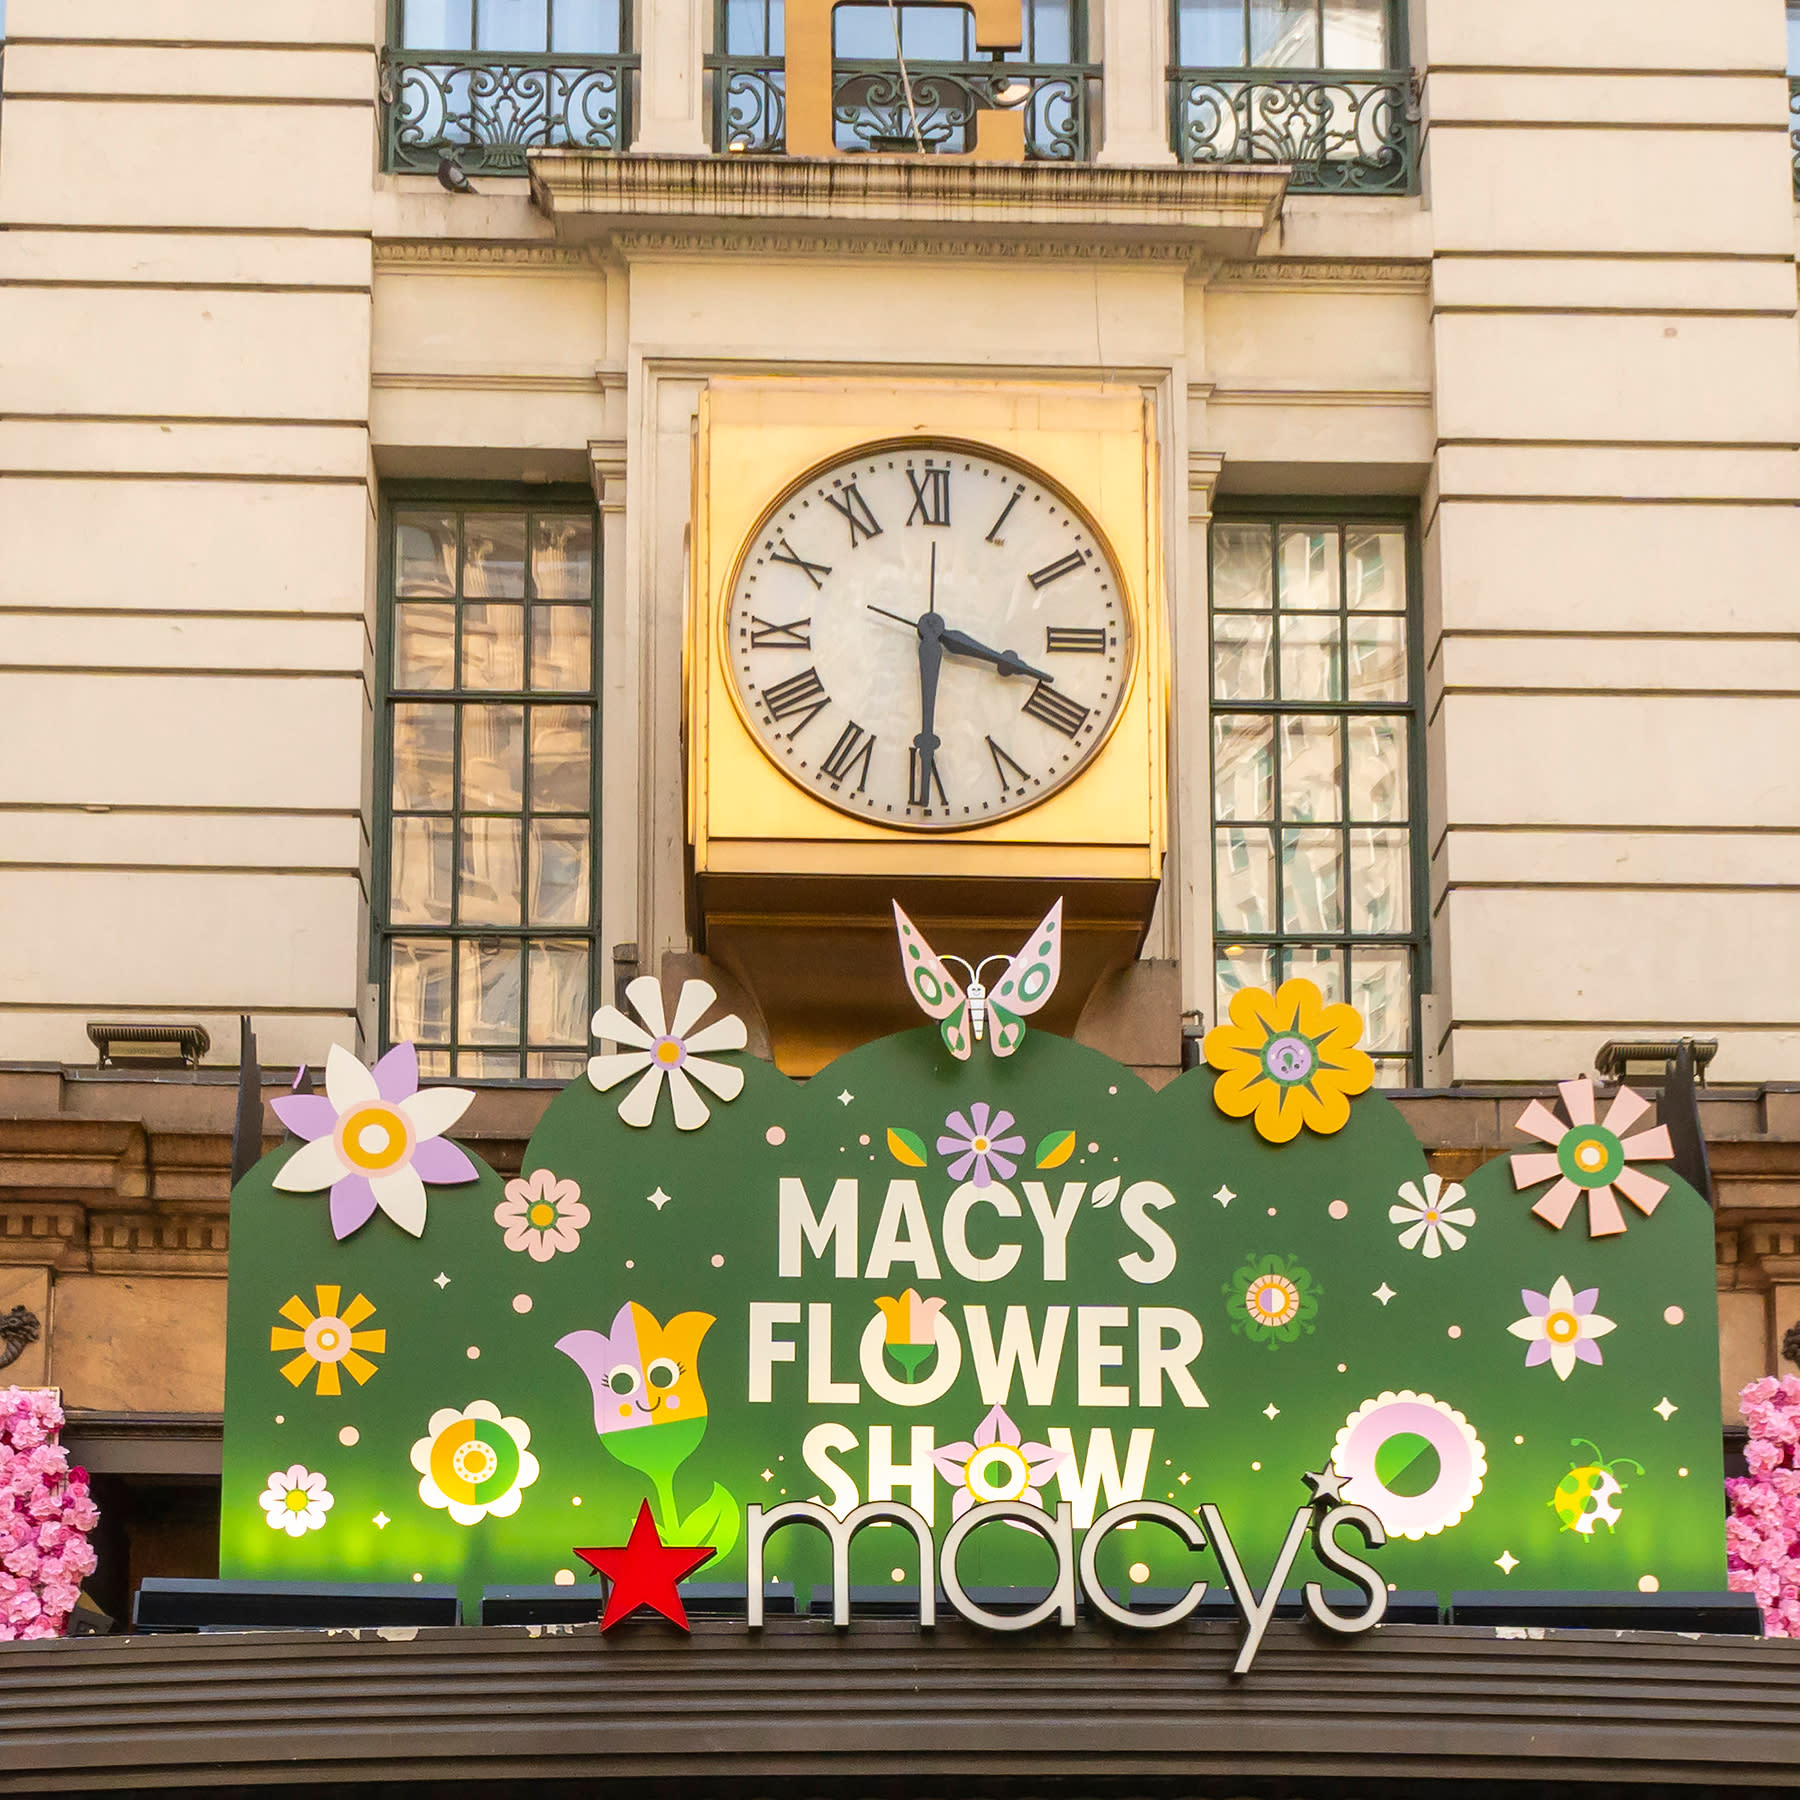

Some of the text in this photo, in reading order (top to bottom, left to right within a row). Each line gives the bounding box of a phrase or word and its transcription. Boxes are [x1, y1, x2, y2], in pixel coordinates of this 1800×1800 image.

[906, 469, 950, 527] XII
[770, 538, 832, 590] X
[777, 1176, 1178, 1284] MACY'S
[747, 1302, 1209, 1410] FLOWER
